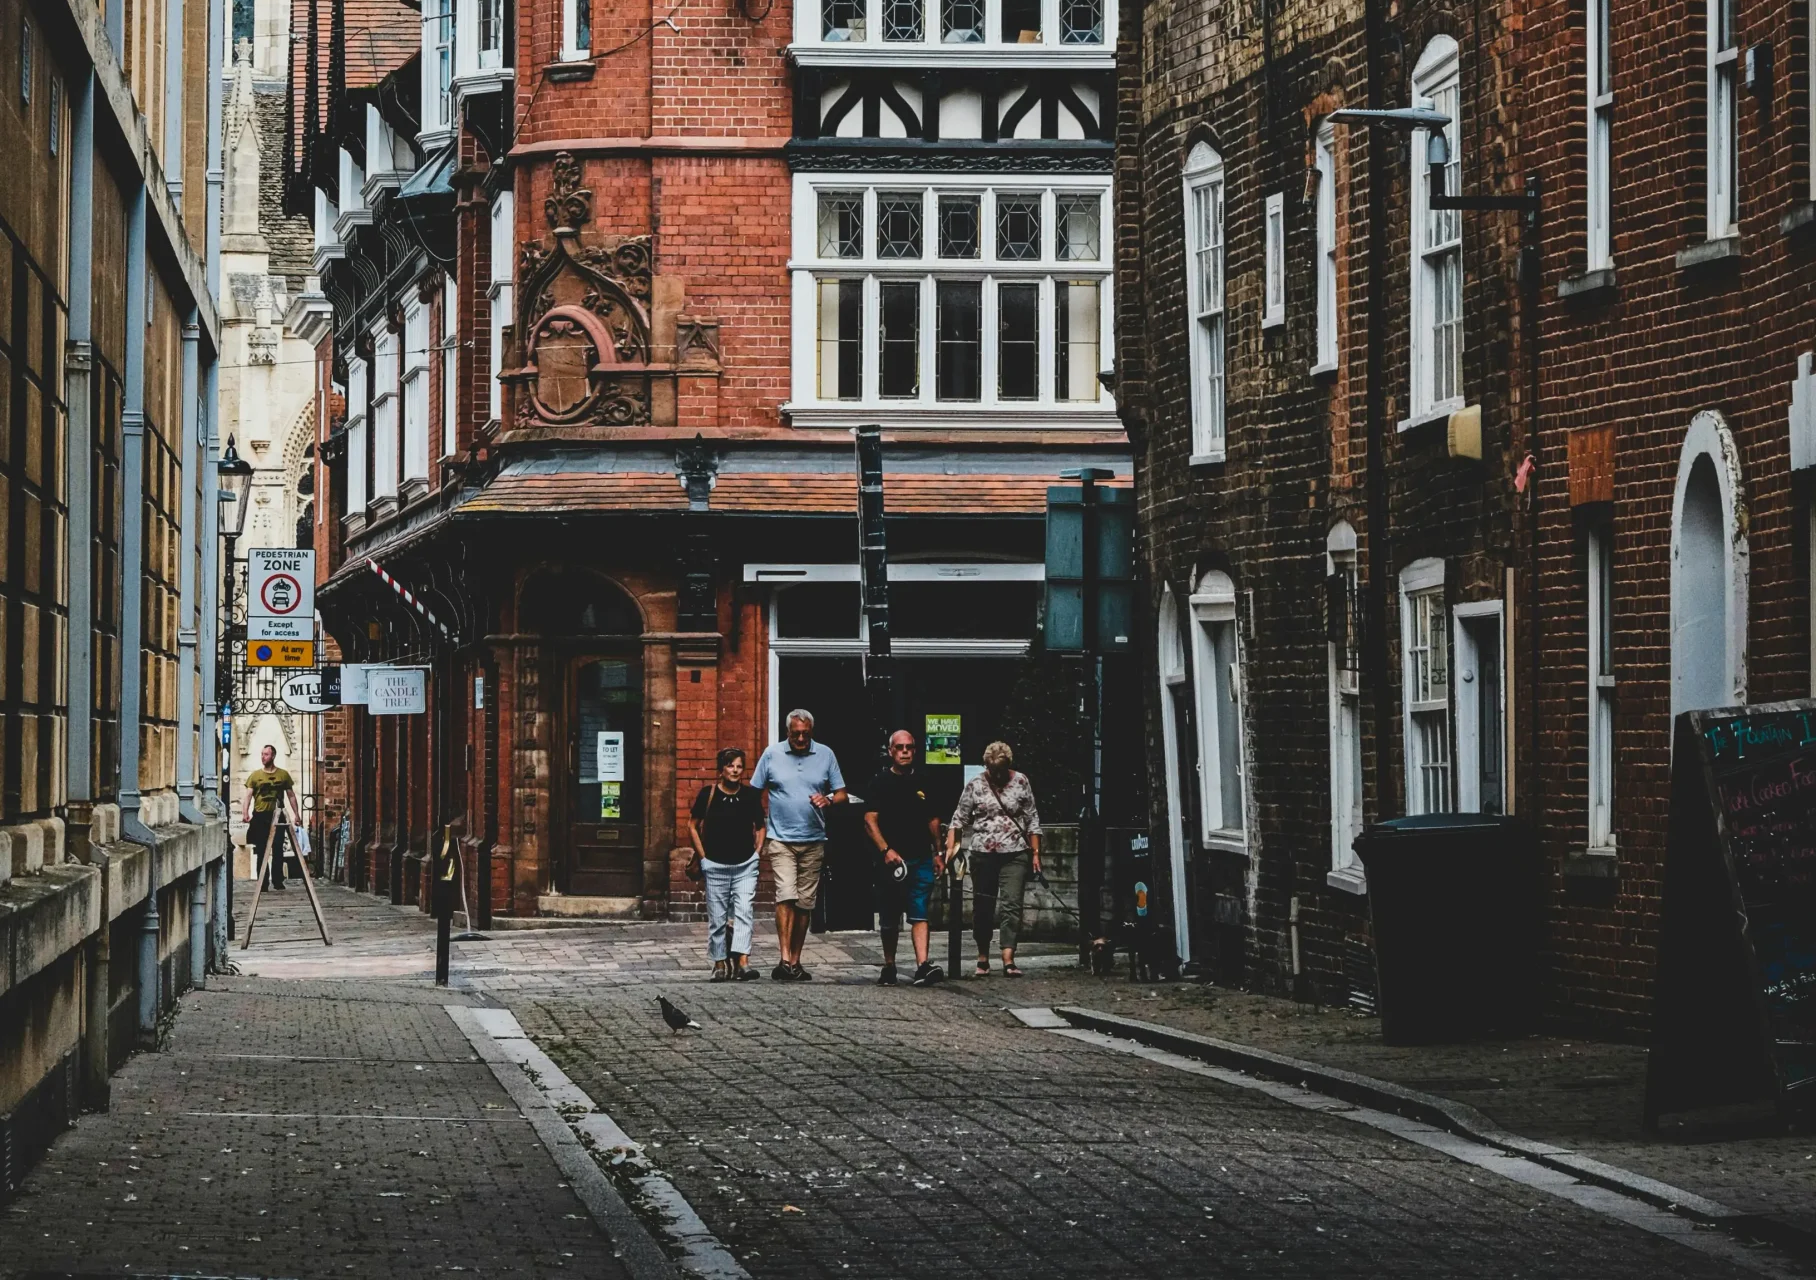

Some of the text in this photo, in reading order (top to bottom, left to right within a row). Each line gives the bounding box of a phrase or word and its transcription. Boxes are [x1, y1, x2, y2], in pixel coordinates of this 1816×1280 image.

[255, 550, 309, 559] PEDESTRIAN
[263, 560, 301, 571] ZONE
[268, 621, 294, 629] Except
[261, 628, 300, 637] for access
[291, 647, 305, 655] any
[284, 653, 301, 662] time
[385, 677, 407, 687] THE
[375, 687, 419, 697] CANDLE
[383, 697, 412, 708] TREE
[927, 724, 959, 732] MOVED
